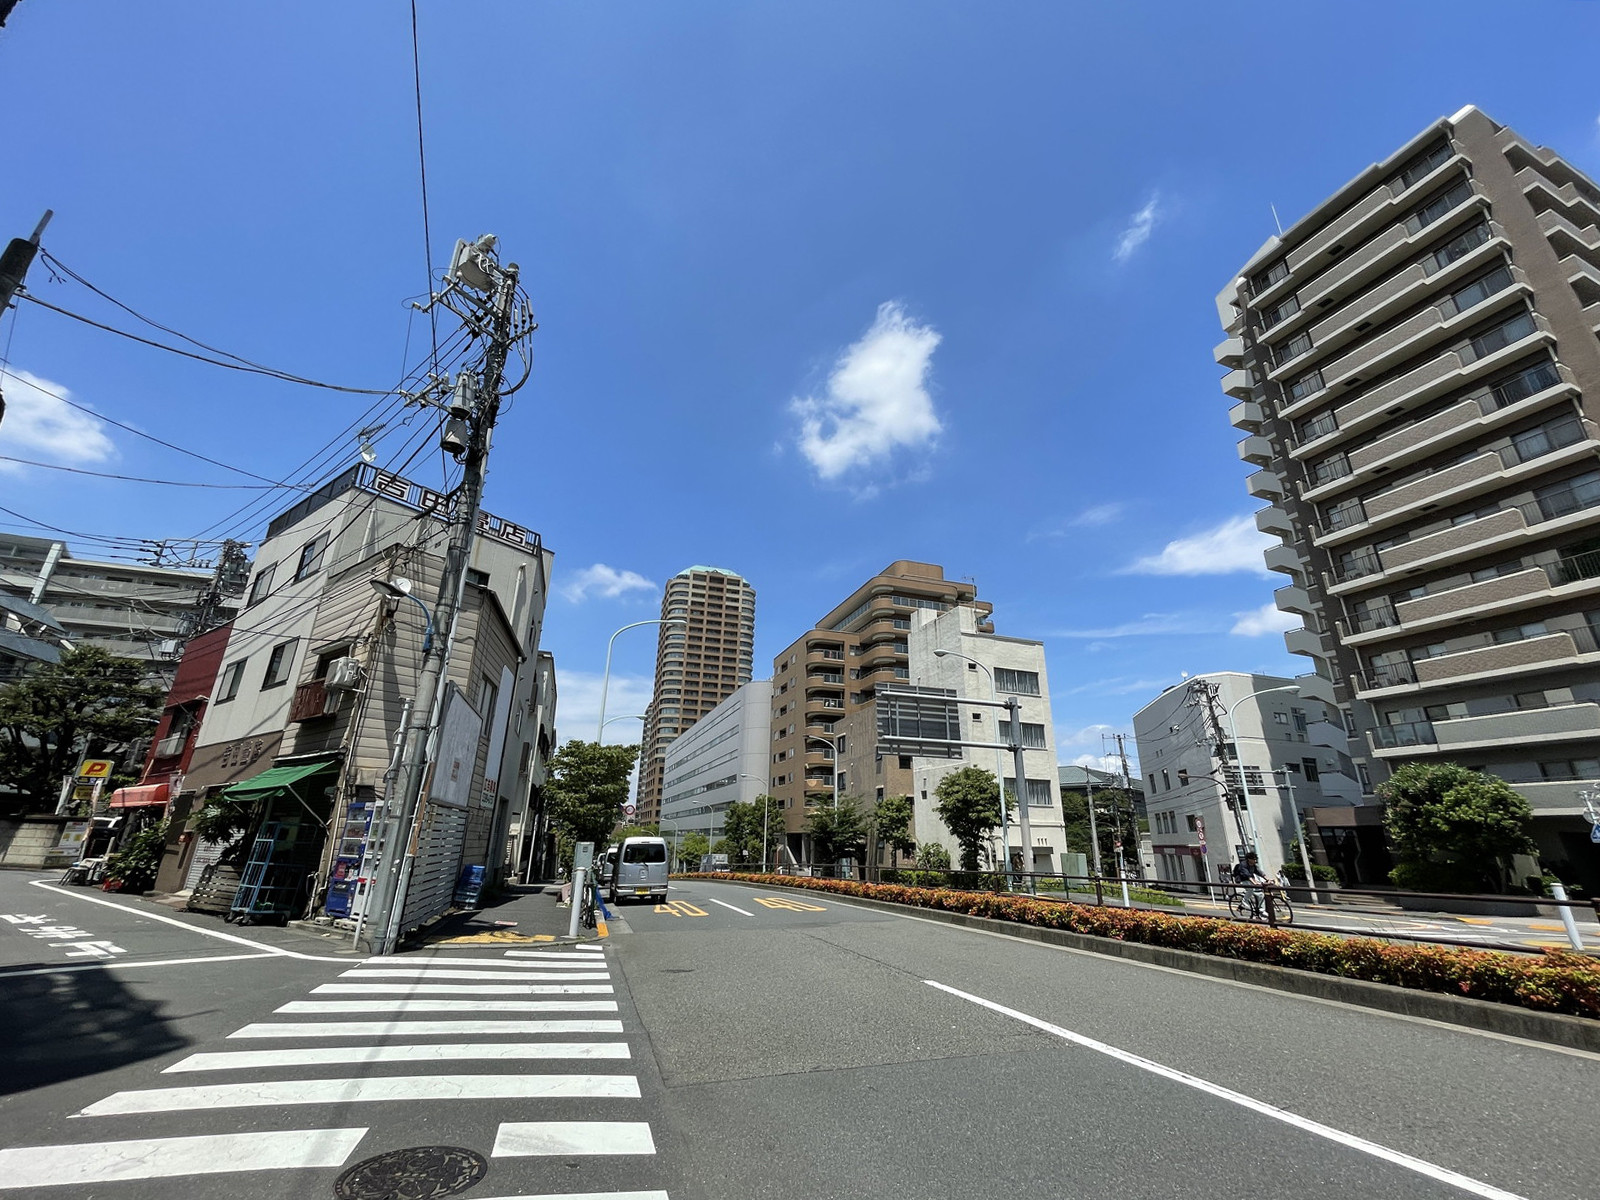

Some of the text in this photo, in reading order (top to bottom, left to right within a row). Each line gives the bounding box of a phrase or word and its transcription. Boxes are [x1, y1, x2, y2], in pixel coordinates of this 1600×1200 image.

[85, 762, 107, 775] P
[653, 900, 709, 917] 40
[753, 897, 828, 912] 40
[0, 914, 127, 960] 止まれ
